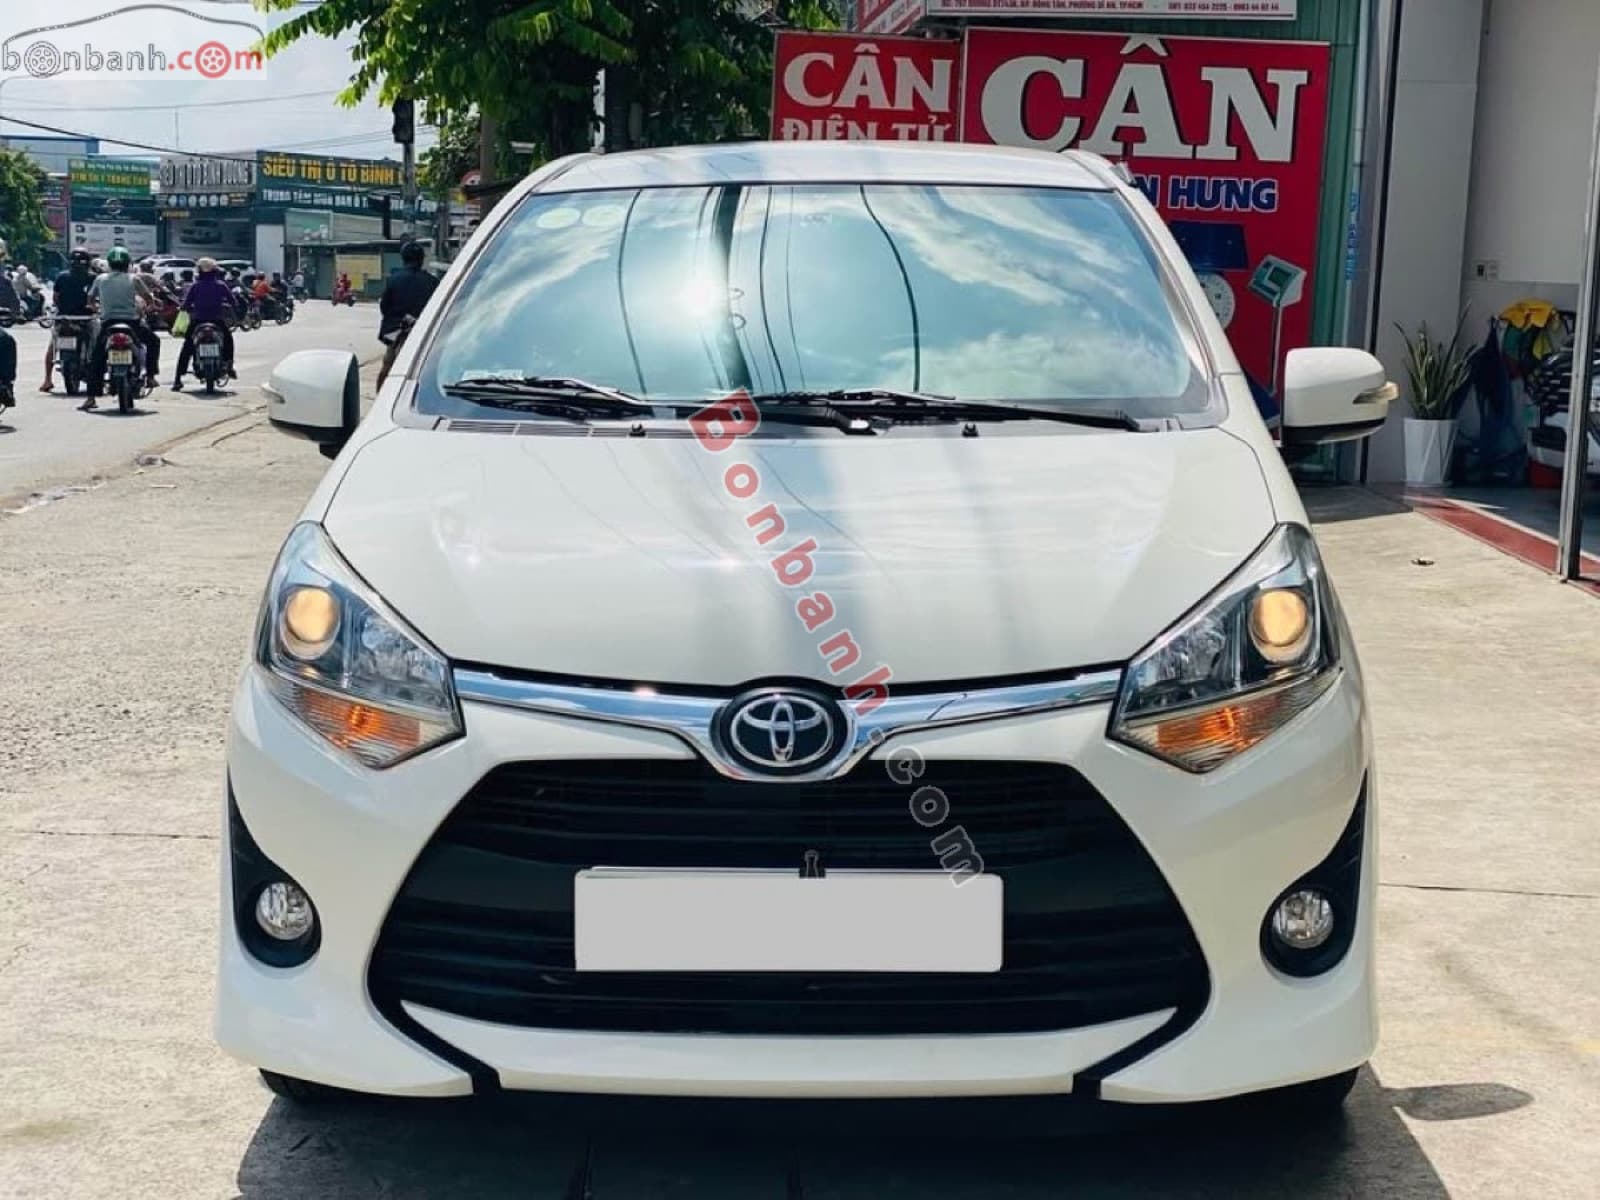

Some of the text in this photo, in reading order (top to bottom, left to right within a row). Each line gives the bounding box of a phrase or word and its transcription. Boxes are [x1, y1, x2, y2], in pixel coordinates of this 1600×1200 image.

[783, 44, 954, 112] CÂN
[981, 36, 1308, 162] CÂN
[262, 154, 295, 177] SIÊU
[300, 159, 321, 183] THỊ
[326, 158, 336, 182] Ô
[340, 160, 358, 183] TÔ
[1168, 175, 1279, 213] HƯNG
